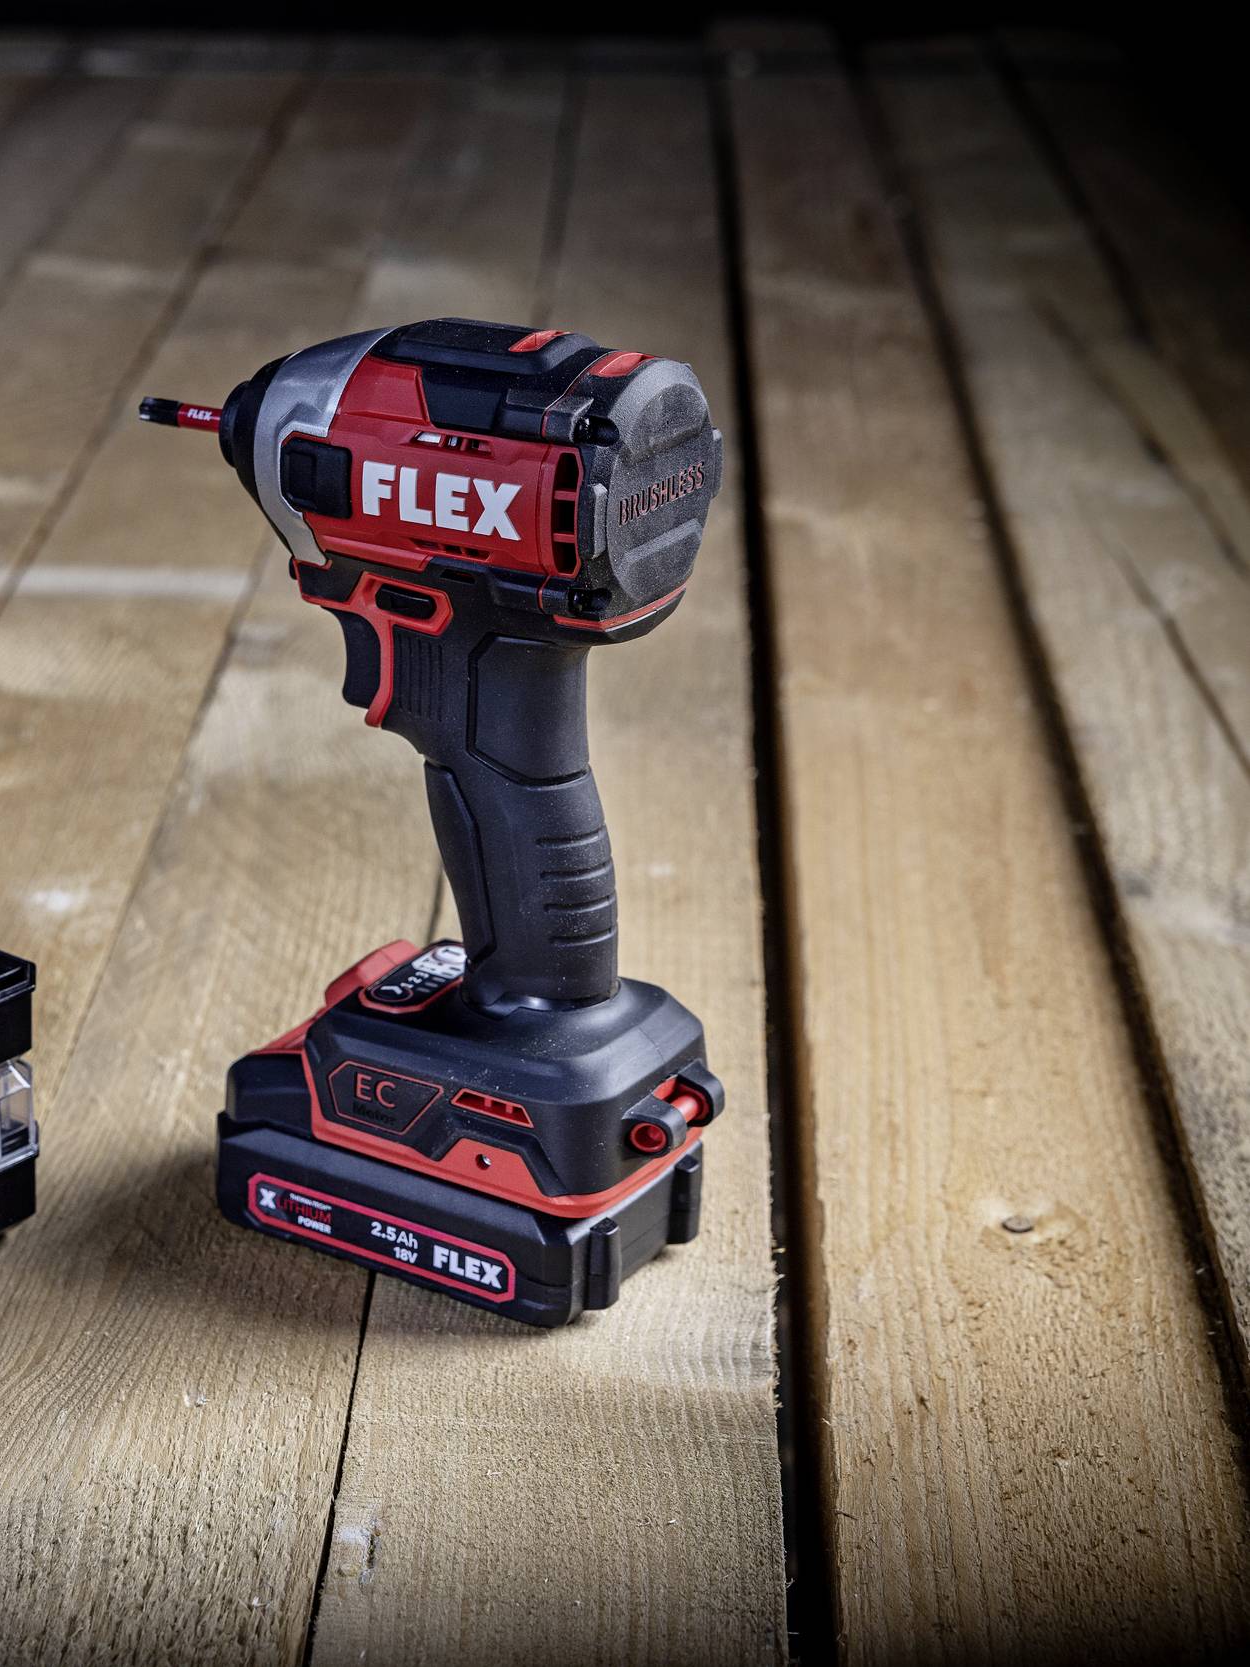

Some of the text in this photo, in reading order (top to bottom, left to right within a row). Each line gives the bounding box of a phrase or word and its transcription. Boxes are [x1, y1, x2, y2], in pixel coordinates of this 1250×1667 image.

[187, 408, 212, 421] FLEX
[362, 460, 522, 541] FLEX
[618, 461, 705, 527] BRUSHLESS
[356, 1073, 396, 1108] EC
[277, 1197, 332, 1225] LITHIUM
[297, 1215, 332, 1235] POWER
[370, 1221, 418, 1249] 2.5Ah
[393, 1246, 418, 1264] 18V
[433, 1244, 503, 1289] FLEX
